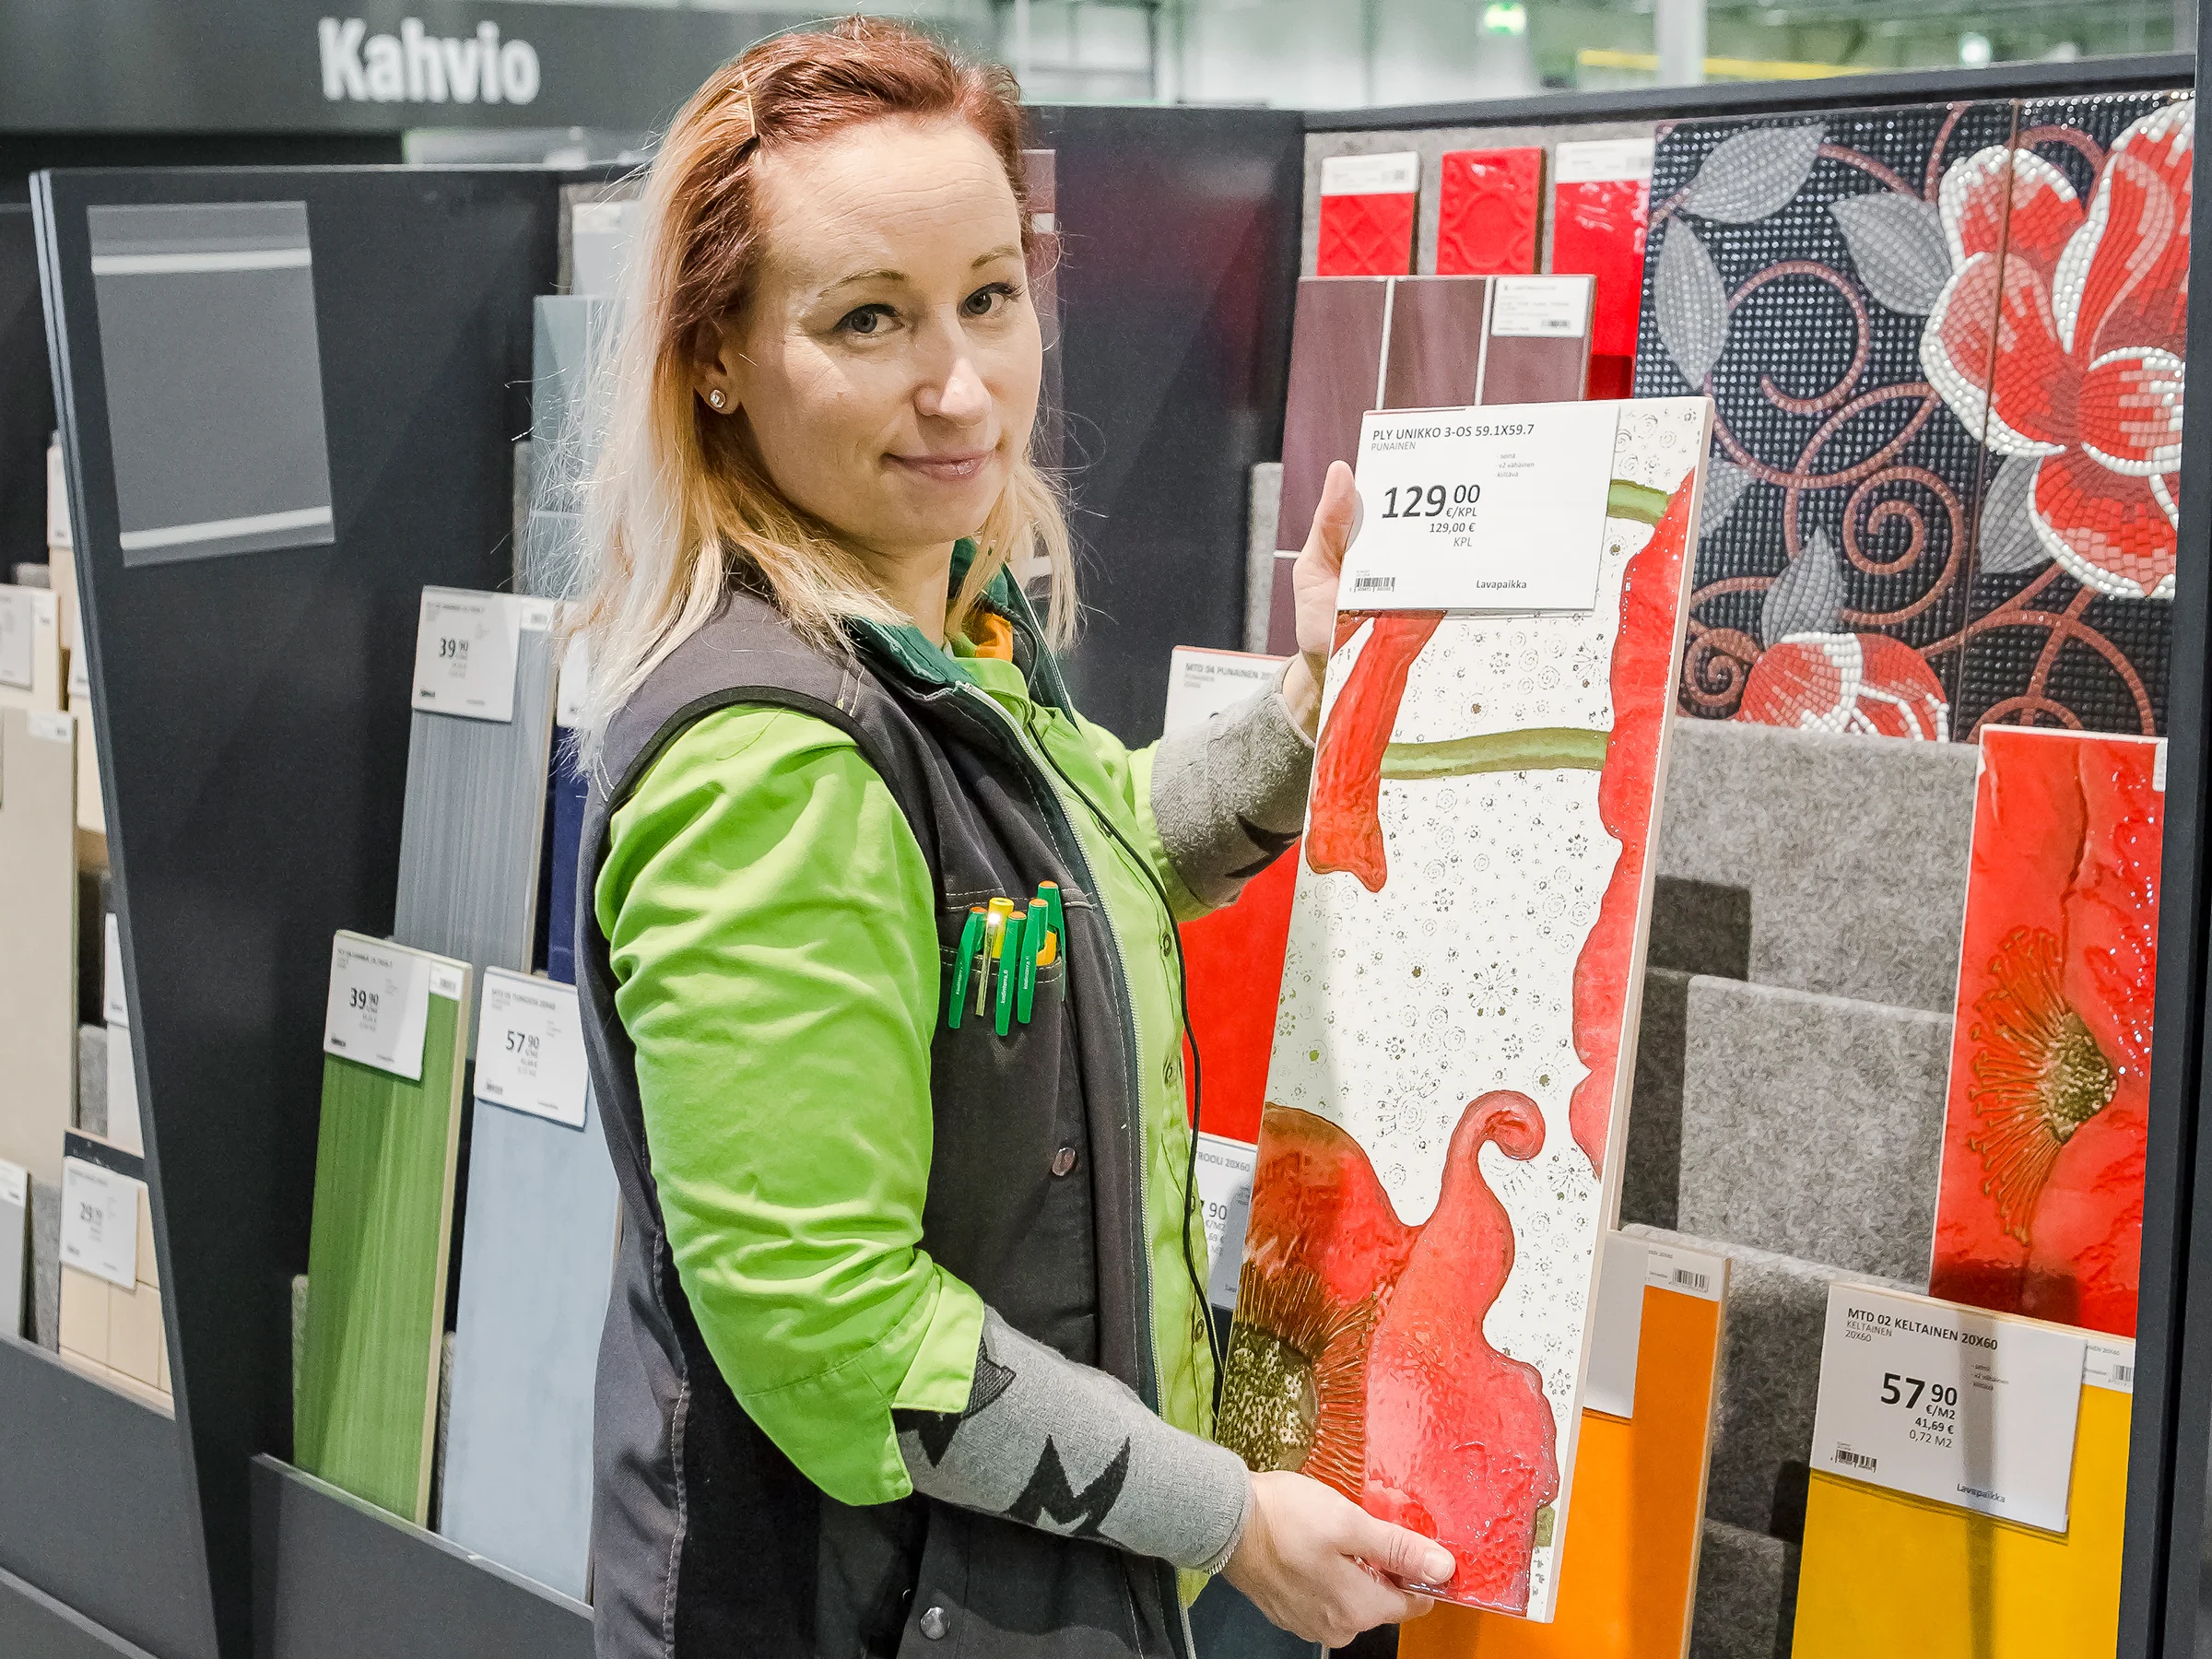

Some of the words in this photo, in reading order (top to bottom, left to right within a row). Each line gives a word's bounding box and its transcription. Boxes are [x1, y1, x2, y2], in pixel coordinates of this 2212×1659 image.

[318, 17, 541, 104] Kahvio
[1372, 429, 1393, 441] PLY
[1396, 427, 1441, 440] UNIKKO
[1444, 426, 1472, 438] 3-OS
[1475, 423, 1535, 436] 59.1X59.7
[1371, 441, 1417, 451] PUNAINEN
[1382, 485, 1447, 519] 129
[1453, 484, 1480, 503] 00
[1446, 506, 1477, 519] €/KPL
[1429, 523, 1465, 535] 129,00
[1468, 523, 1476, 532] €
[1453, 536, 1473, 547] KPL
[1476, 580, 1527, 590] Lavapaikka
[440, 637, 456, 658] 39
[1217, 665, 1259, 678] PUNAINEN
[1000, 969, 1008, 1004] kodinterra.fi
[349, 987, 367, 1010] 39
[505, 1030, 525, 1053] 57
[528, 1034, 540, 1050] 90
[1225, 1159, 1251, 1171] 20X60
[1209, 1202, 1228, 1220] 90
[1844, 1329, 1872, 1343] 20X60
[1846, 1320, 1892, 1336] KELTAINEN
[1847, 1307, 1875, 1323] MTD
[1877, 1314, 1891, 1326] 02
[1894, 1317, 1959, 1341] KELTAINEN
[1961, 1333, 1998, 1350] 20X60
[1880, 1371, 1925, 1409] 57
[1931, 1383, 1958, 1406] 90
[1925, 1404, 1956, 1419] €/M2
[1914, 1418, 1944, 1431] 41,69
[1947, 1424, 1955, 1434] €
[1909, 1430, 1932, 1443] 0,72
[1935, 1435, 1952, 1448] M2
[1957, 1483, 2006, 1503] Lavapaikka
